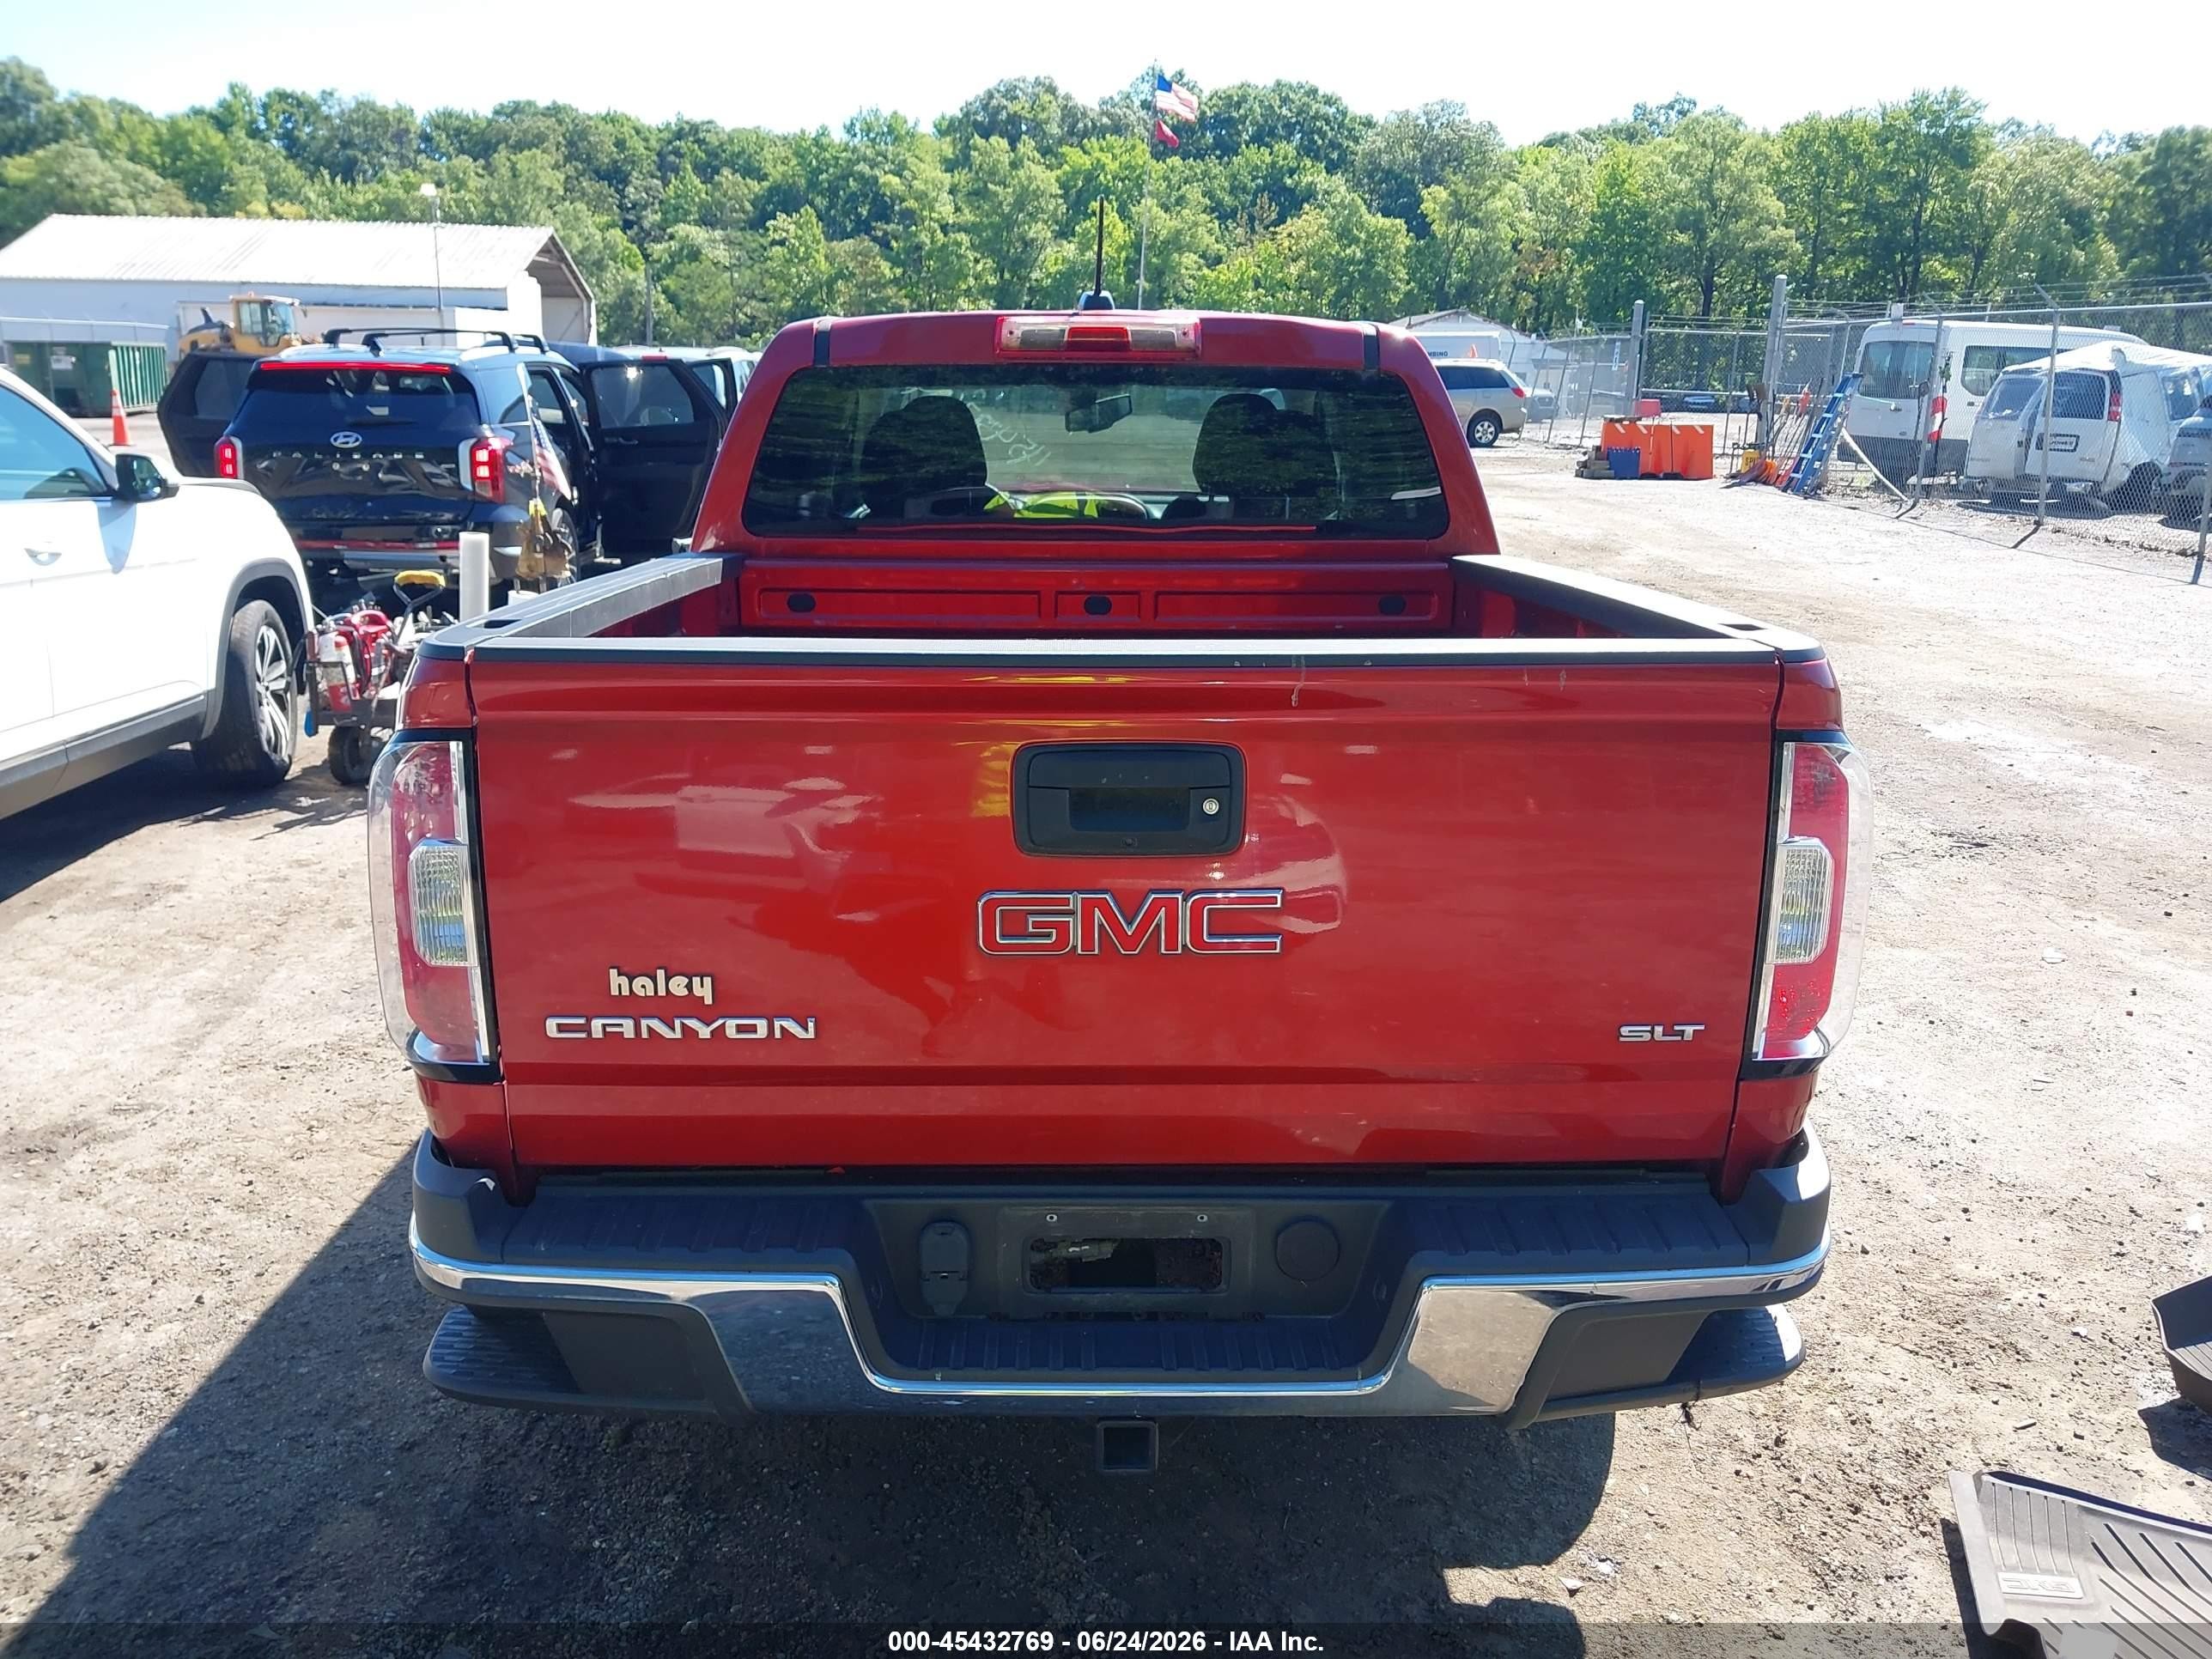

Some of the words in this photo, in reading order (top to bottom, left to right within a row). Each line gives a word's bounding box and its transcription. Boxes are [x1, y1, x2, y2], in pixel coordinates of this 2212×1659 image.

[977, 889, 1285, 956] GMC
[609, 966, 714, 1005] haley
[544, 1015, 817, 1040] CANYON
[1618, 1023, 1705, 1042] SLT
